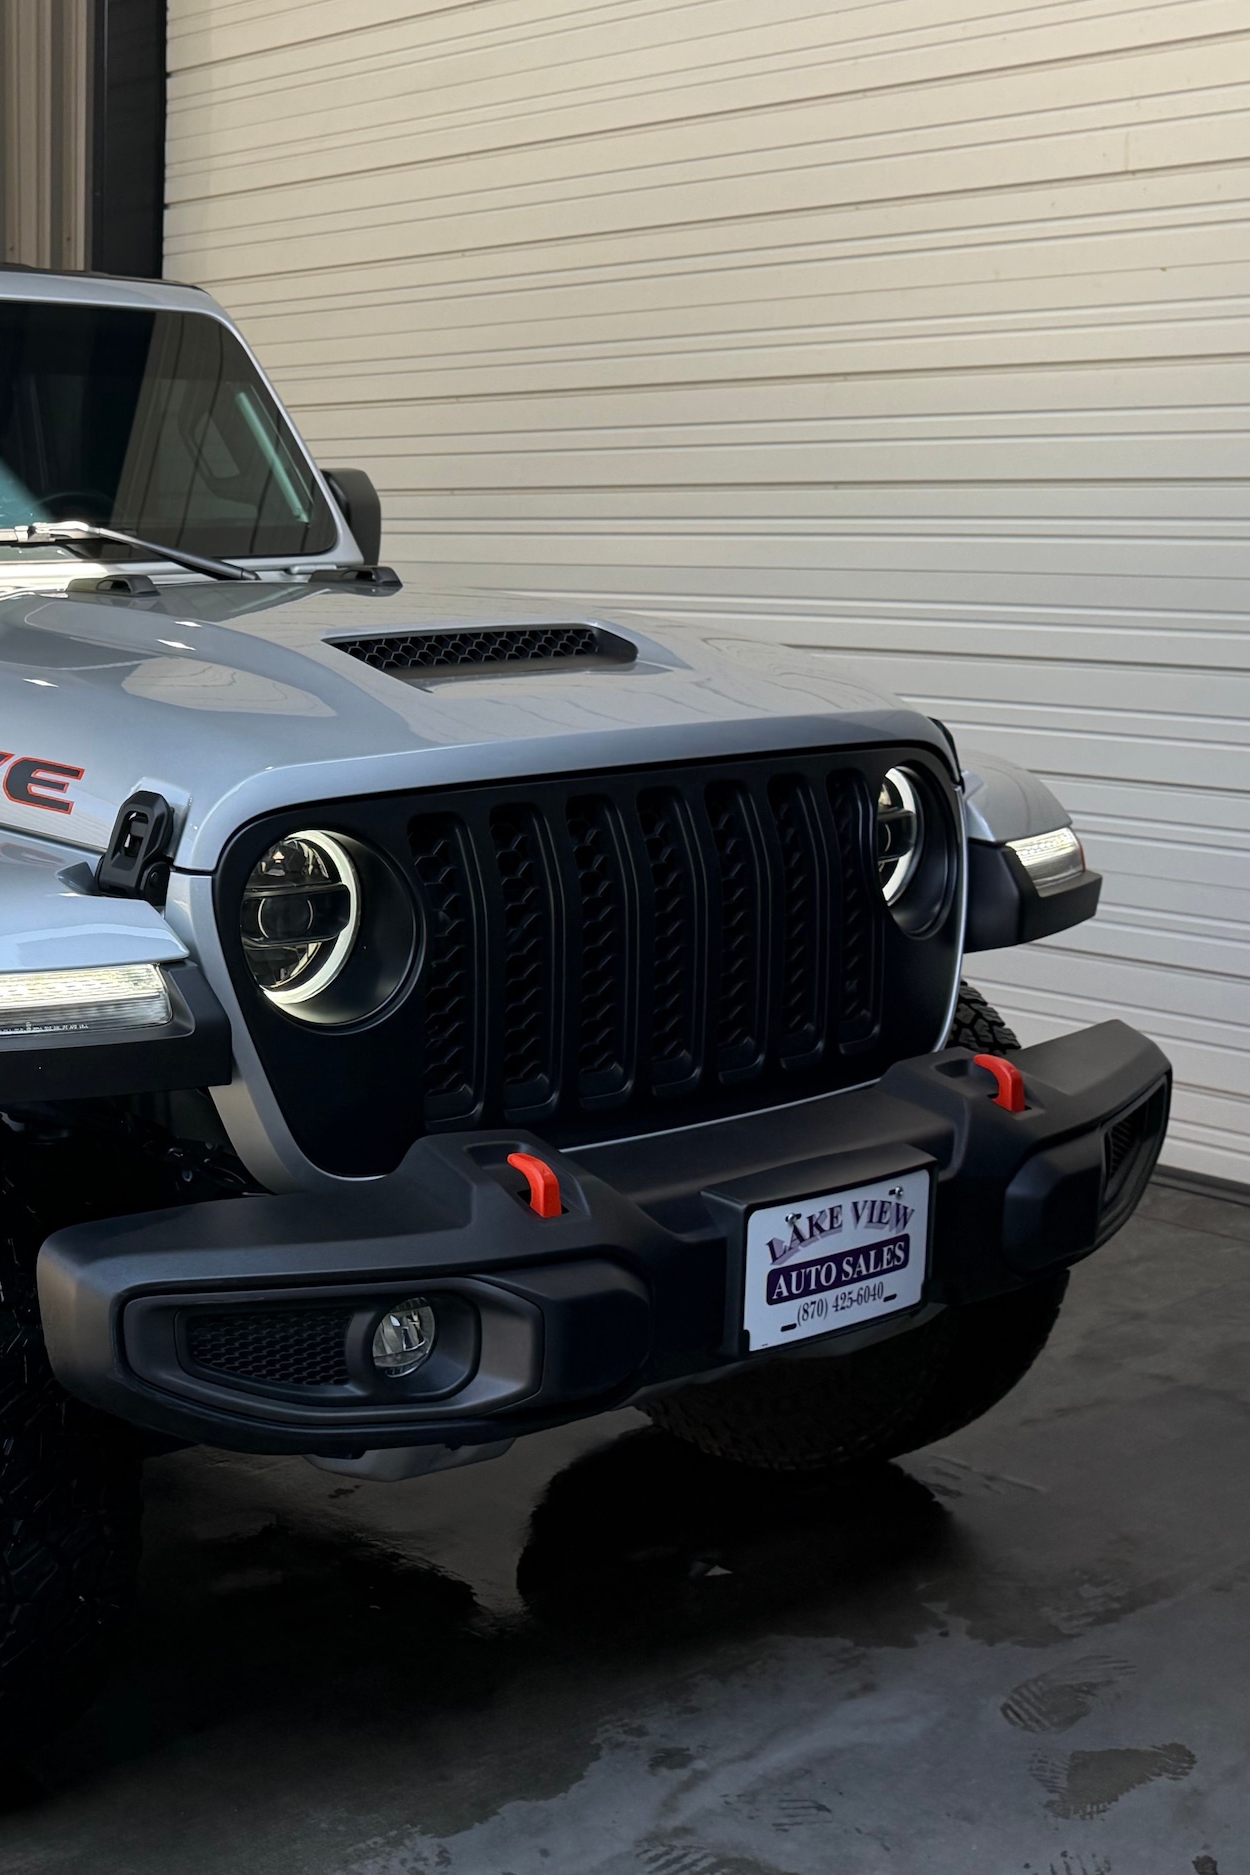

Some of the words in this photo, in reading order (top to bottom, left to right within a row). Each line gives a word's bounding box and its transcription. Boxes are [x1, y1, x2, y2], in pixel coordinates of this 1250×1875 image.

[766, 1204, 843, 1265] LAKE
[851, 1200, 915, 1233] VIEW
[772, 1261, 837, 1299] AUTO
[841, 1241, 905, 1281] SALES
[796, 1298, 828, 1326] (870)
[832, 1281, 884, 1313] 425-6040
